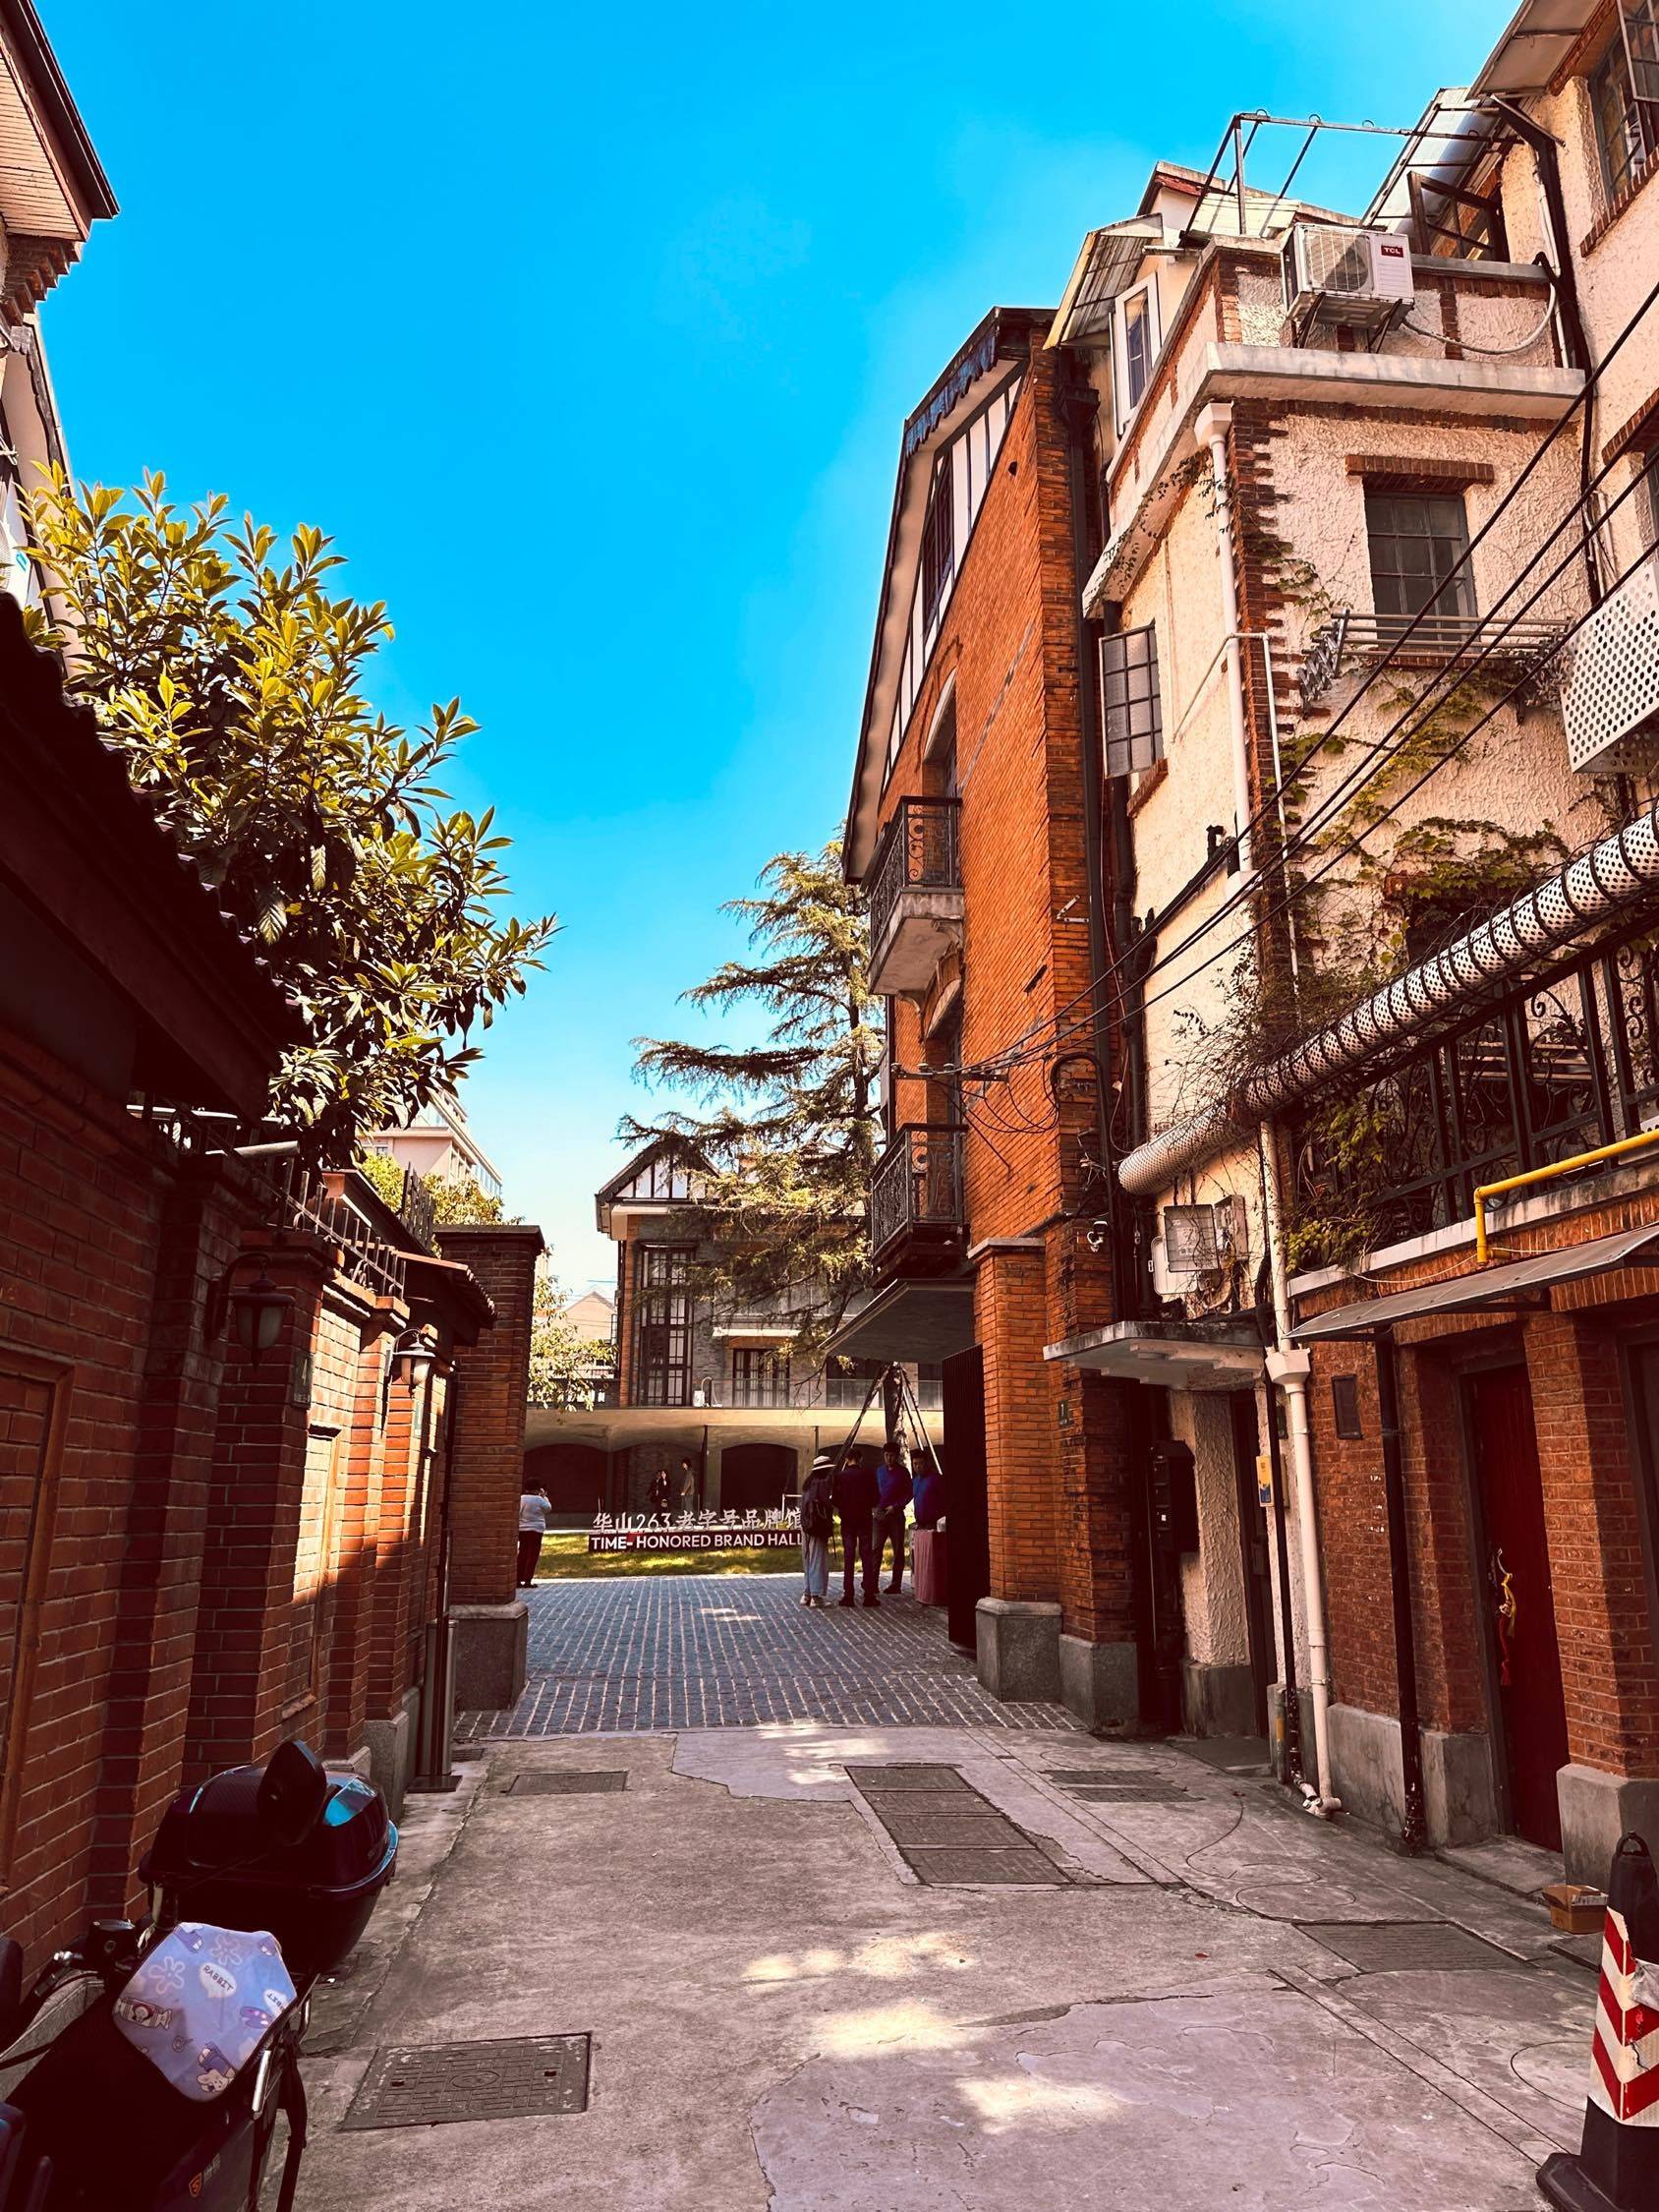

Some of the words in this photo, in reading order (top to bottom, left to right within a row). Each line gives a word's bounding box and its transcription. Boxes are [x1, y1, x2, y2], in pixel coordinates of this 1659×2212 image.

[636, 1535, 711, 1548] HONORED
[715, 1534, 765, 1547] BRAND
[768, 1533, 802, 1546] HALL
[202, 1965, 234, 1991] RABBIT
